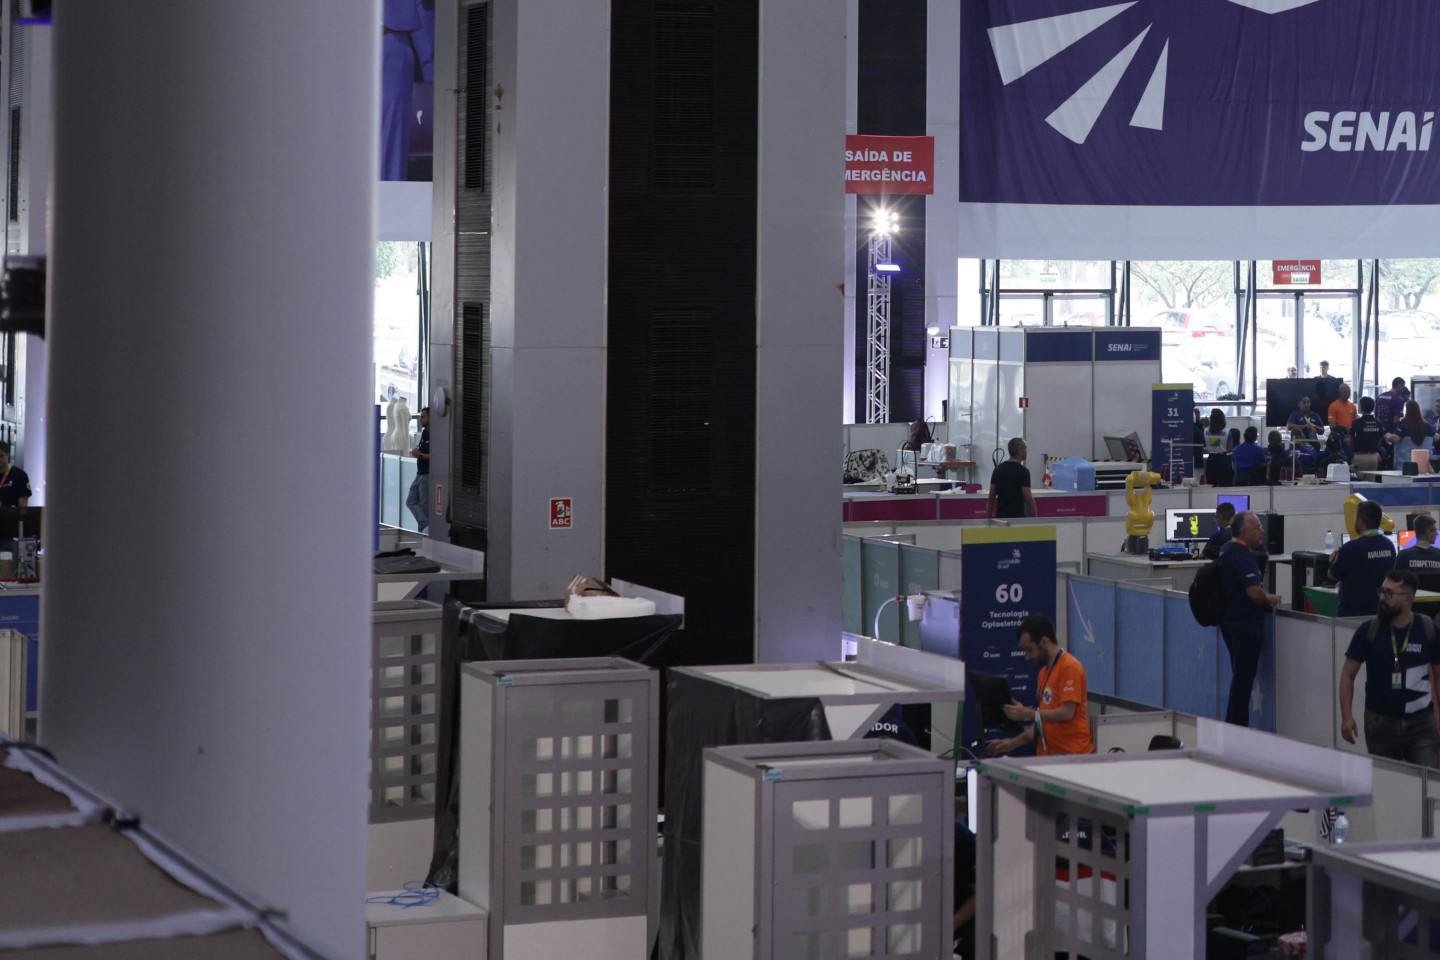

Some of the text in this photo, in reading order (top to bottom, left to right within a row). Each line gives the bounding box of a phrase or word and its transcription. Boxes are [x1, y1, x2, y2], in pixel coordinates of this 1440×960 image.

[845, 148, 912, 162] SAÍDA DE
[845, 168, 927, 182] ERGÊNCIA
[1168, 407, 1179, 417] 31
[995, 583, 1023, 603] 60
[989, 610, 1029, 619] Tecnologia
